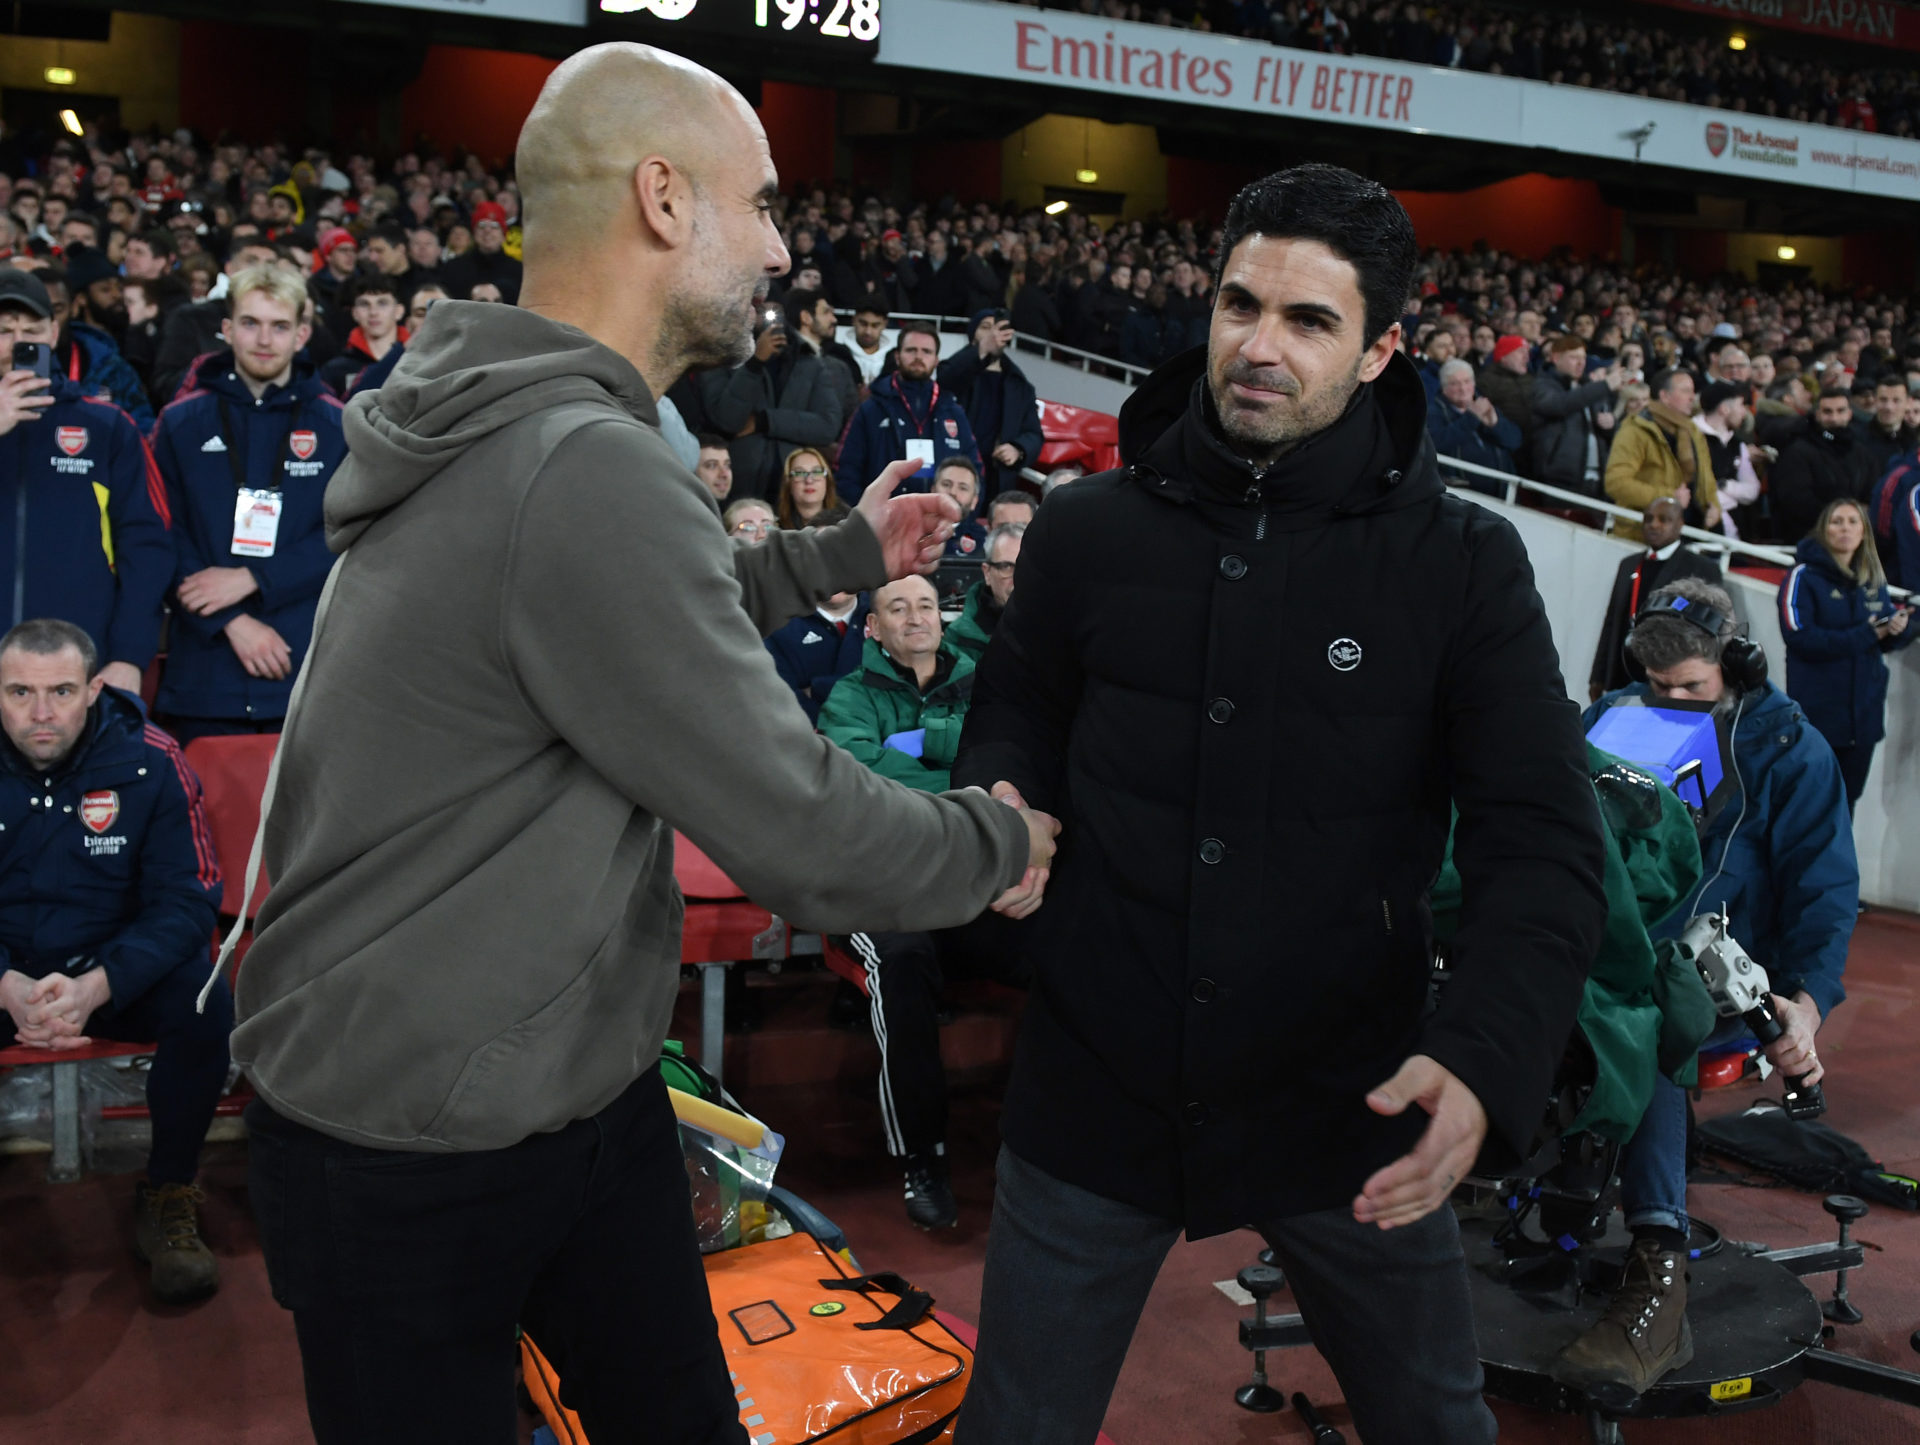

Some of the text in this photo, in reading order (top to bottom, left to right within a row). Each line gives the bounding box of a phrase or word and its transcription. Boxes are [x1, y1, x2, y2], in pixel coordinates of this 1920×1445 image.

[754, 0, 880, 41] 19:28
[1800, 0, 1896, 39] JAPAN
[1015, 20, 1414, 121] Emirates FLY BETTER
[1732, 126, 1799, 151] The Arsenal
[1732, 143, 1799, 167] Foundation
[1811, 148, 1920, 181] www.arsenal.com/
